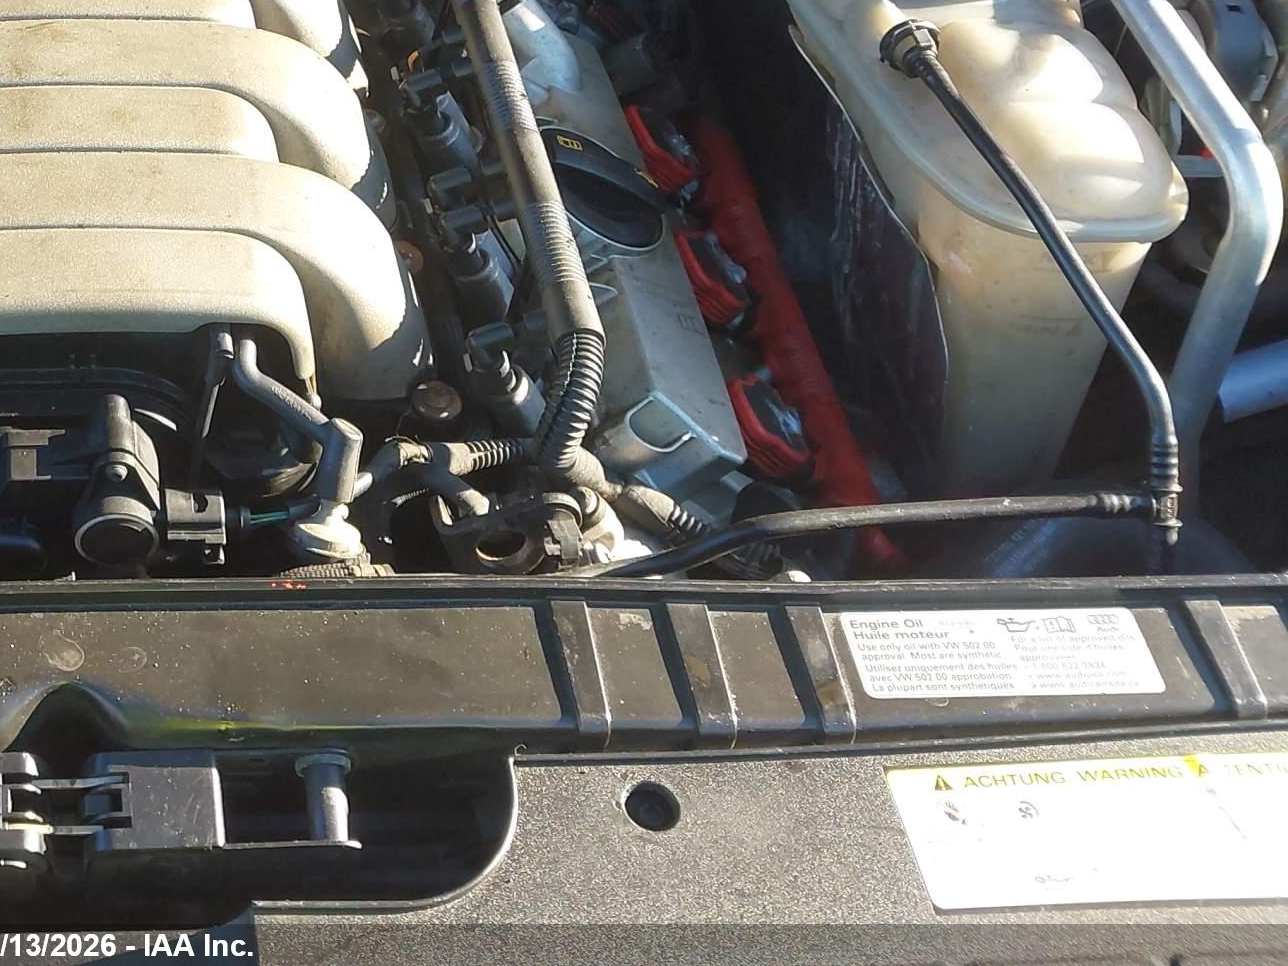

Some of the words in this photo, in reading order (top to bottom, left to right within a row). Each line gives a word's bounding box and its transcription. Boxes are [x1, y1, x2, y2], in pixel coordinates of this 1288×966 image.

[849, 619, 899, 630] Engine
[903, 618, 924, 628] Oil
[854, 630, 890, 640] Huile
[895, 630, 949, 639] moteur
[857, 643, 877, 651] Use
[880, 642, 901, 653] only
[903, 642, 918, 651] oil
[919, 641, 940, 650] with
[942, 641, 960, 650] VW
[964, 641, 980, 650] 502
[983, 641, 996, 650] 00
[911, 652, 936, 660] Most
[939, 652, 954, 660] are
[865, 663, 902, 672] Utilisez
[904, 663, 965, 674] uniquement
[870, 674, 893, 682] avec
[894, 673, 912, 682] VW
[915, 673, 932, 682] 502
[935, 673, 948, 681] 00
[872, 683, 886, 692] La
[887, 682, 922, 693] plupart
[925, 683, 948, 691] sont
[963, 772, 1065, 789] ACHTUNG
[1076, 766, 1184, 783] WARNING
